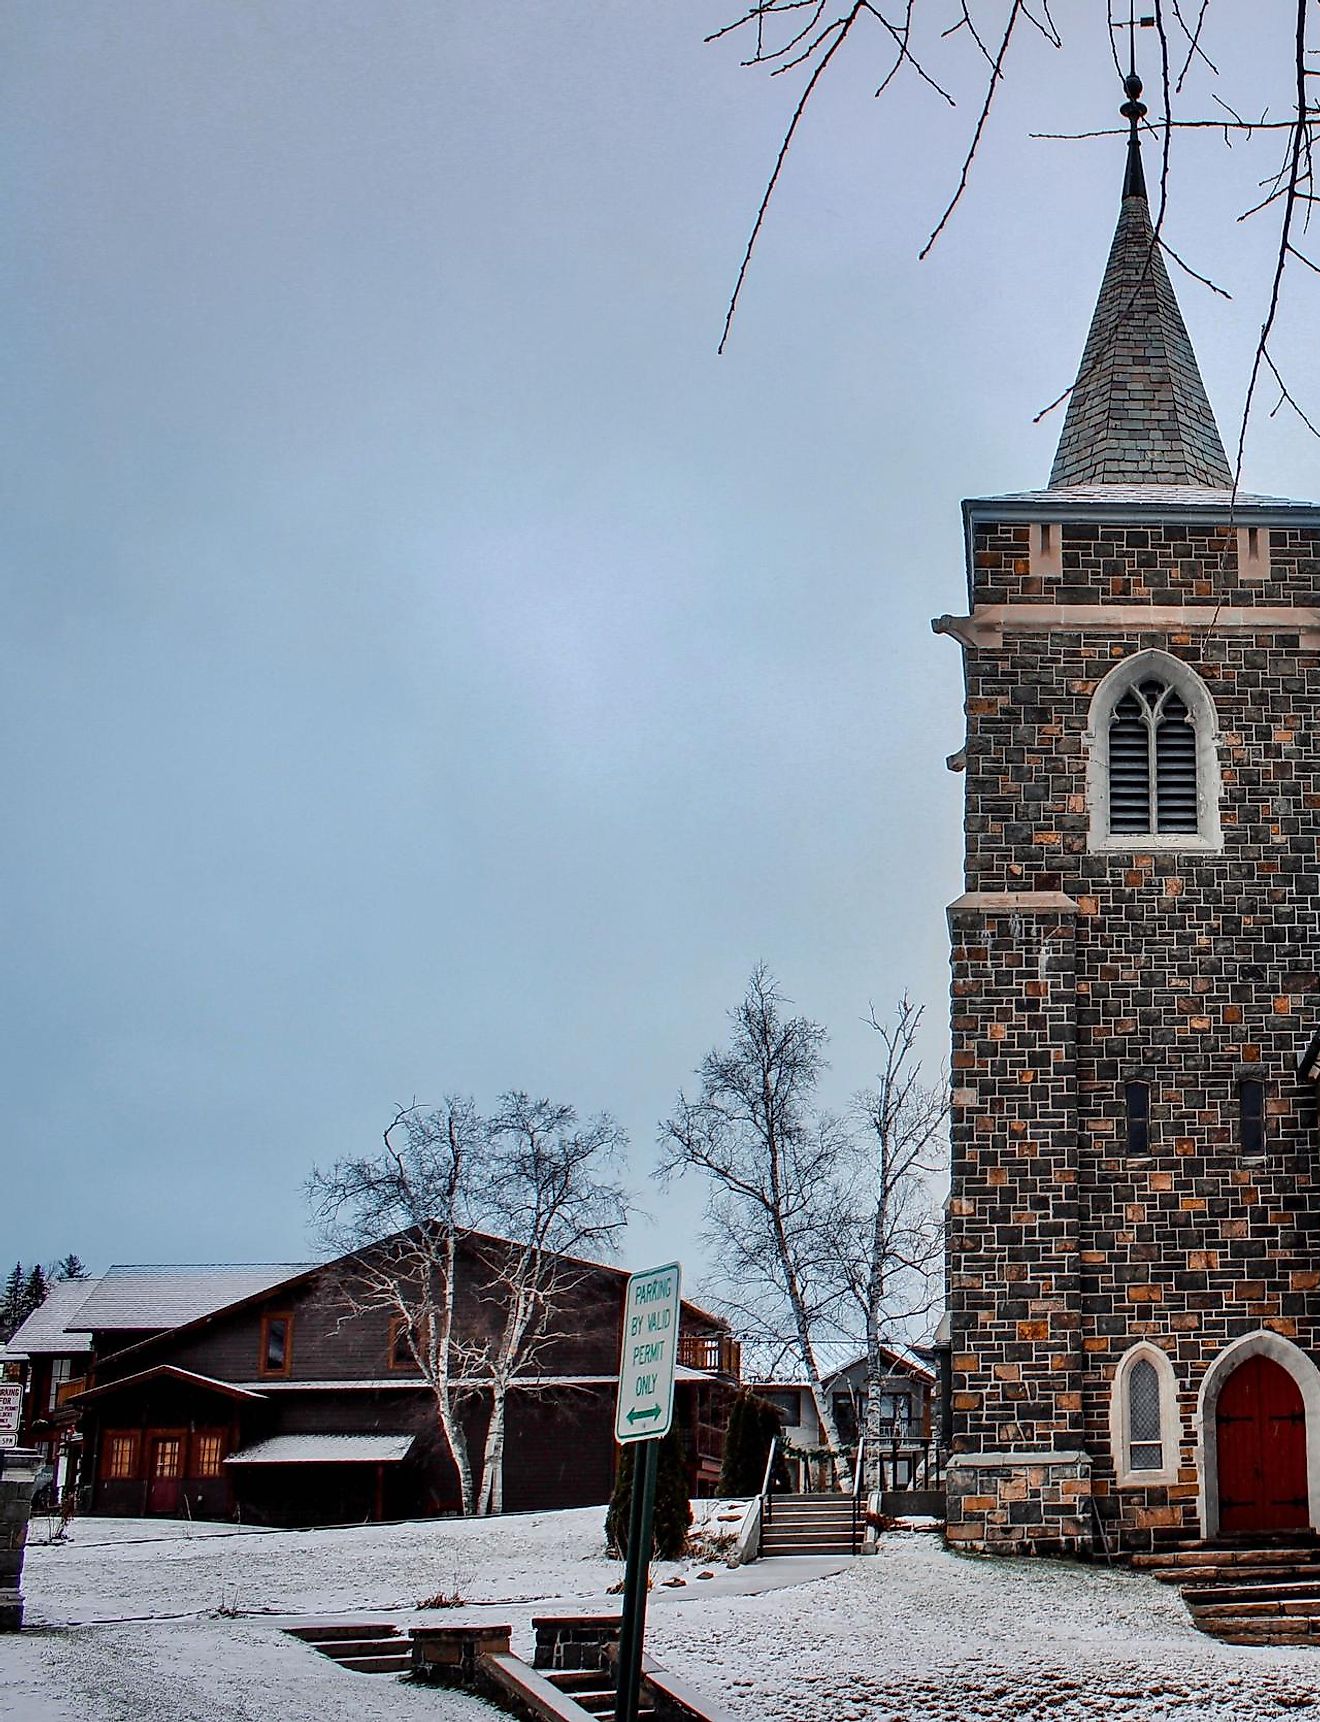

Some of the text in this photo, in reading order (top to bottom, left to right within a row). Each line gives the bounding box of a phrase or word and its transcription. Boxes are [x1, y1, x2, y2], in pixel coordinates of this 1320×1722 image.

[635, 1278, 671, 1305] PARKING
[631, 1309, 670, 1336] BY VALID
[633, 1340, 665, 1366] PERMIT
[636, 1373, 658, 1397] ONLY
